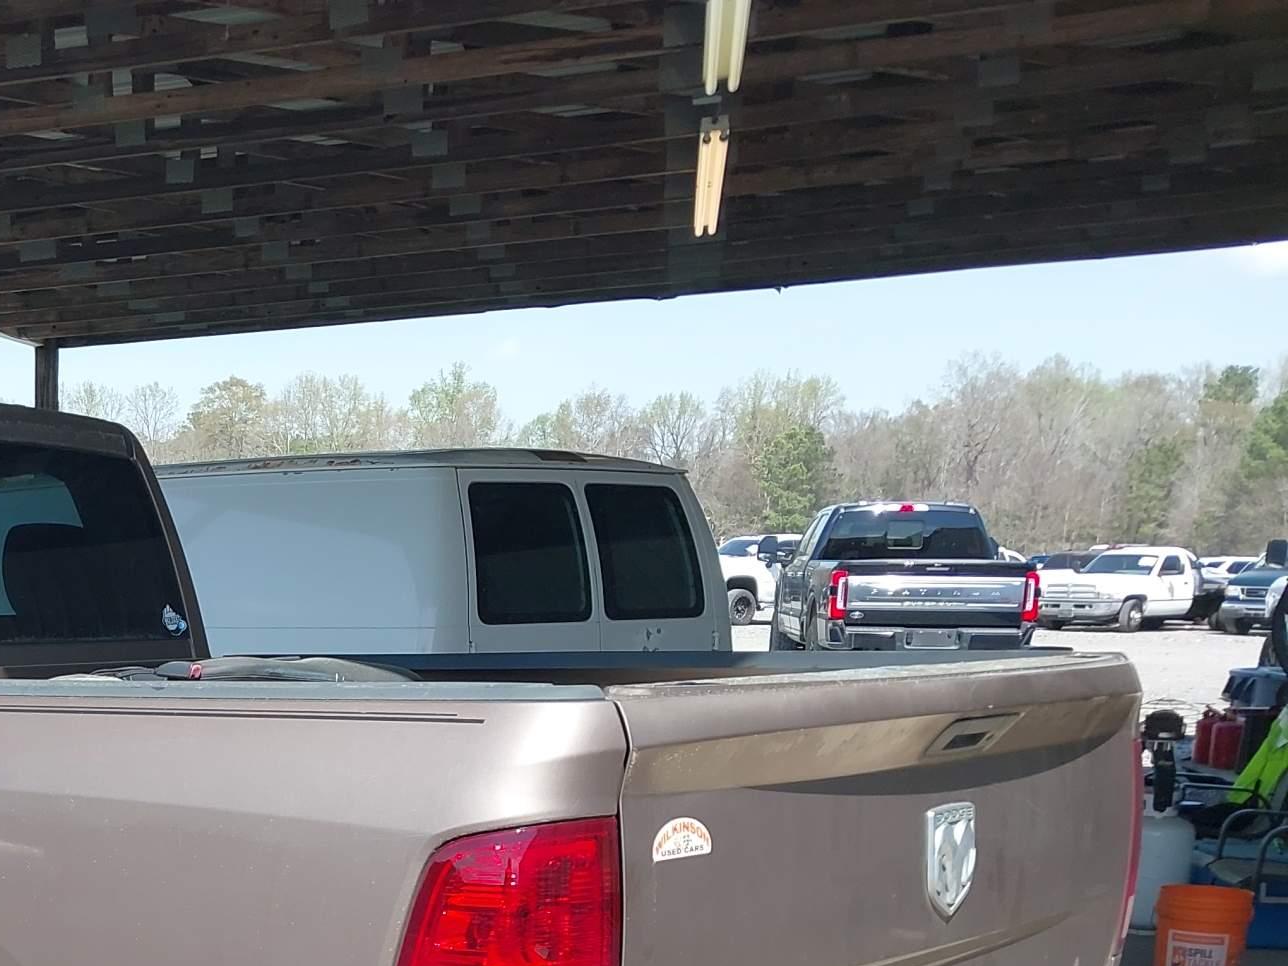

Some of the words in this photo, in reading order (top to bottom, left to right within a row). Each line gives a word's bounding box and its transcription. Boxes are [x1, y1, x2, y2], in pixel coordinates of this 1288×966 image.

[935, 807, 974, 825] DODGE
[654, 821, 710, 856] WILKINSON
[661, 848, 682, 857] USED
[683, 845, 705, 853] CARS
[1187, 948, 1213, 959] SPILL
